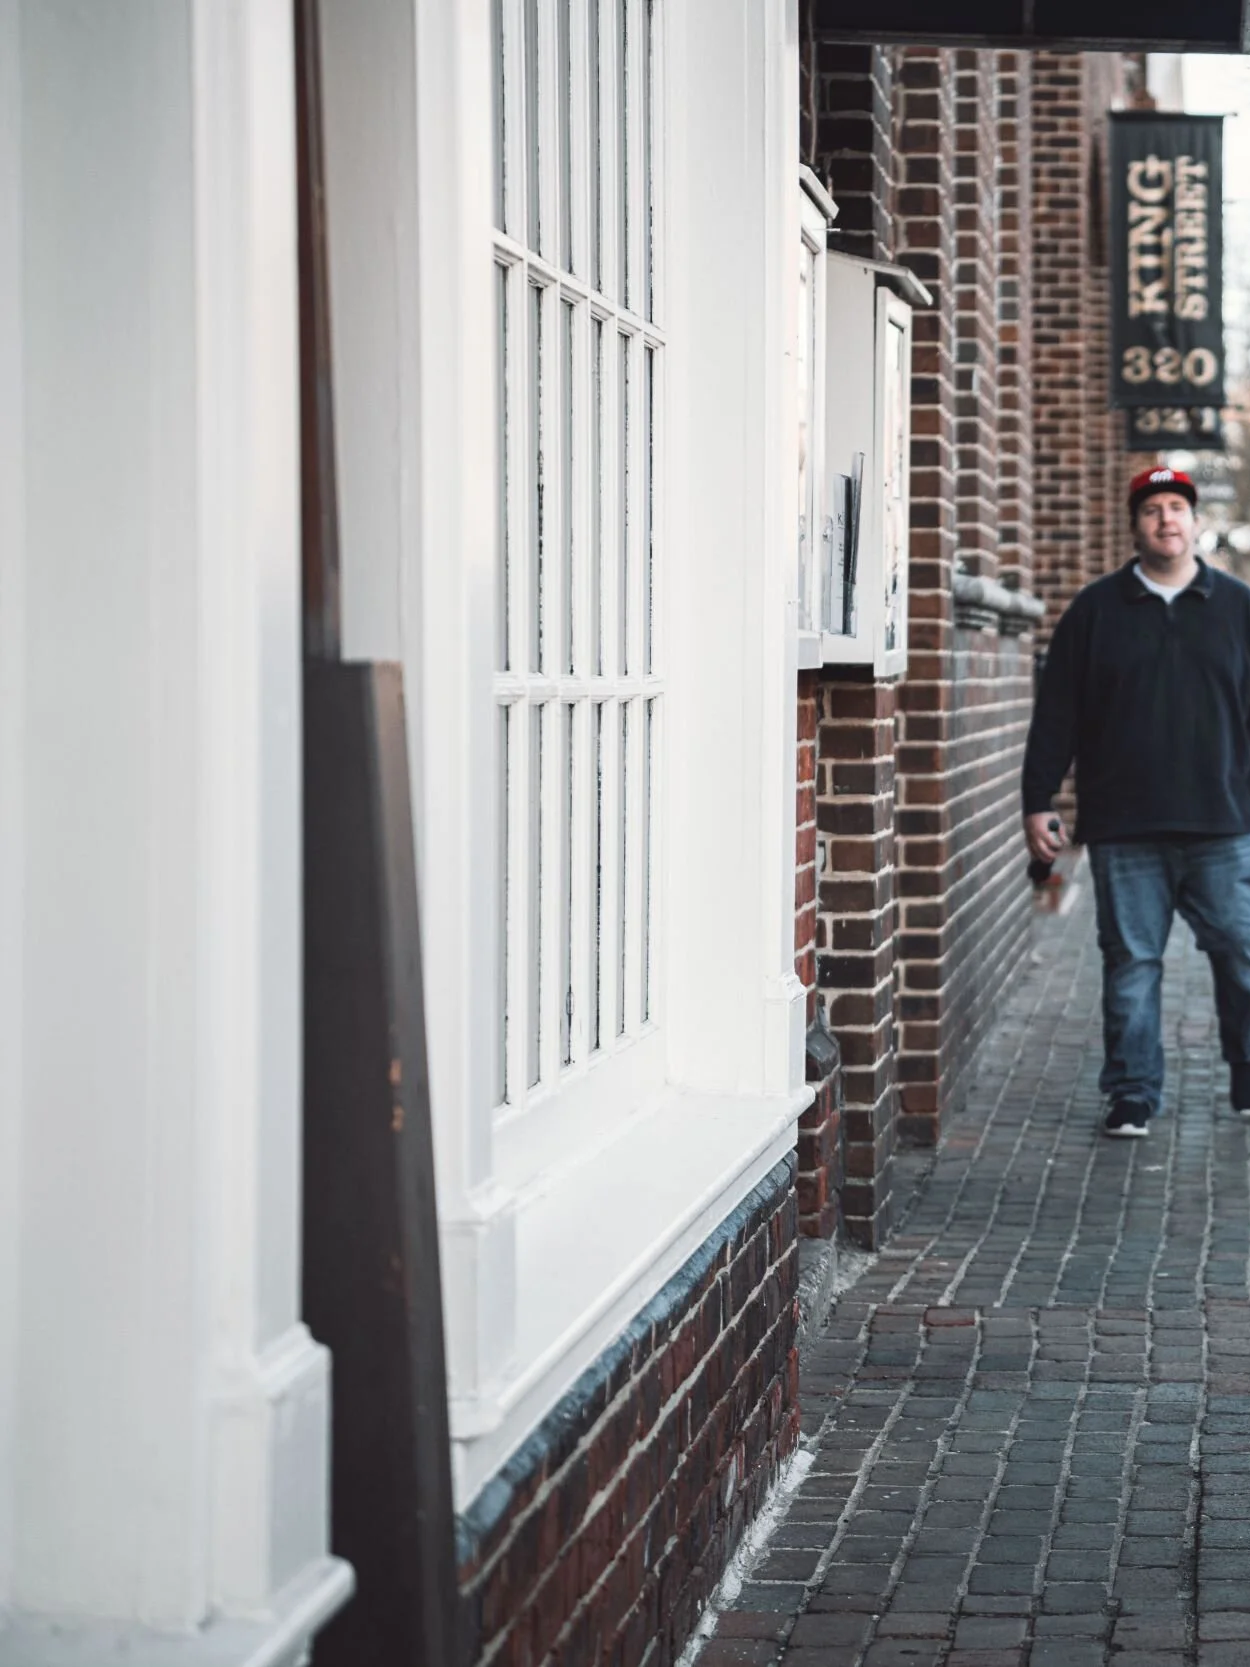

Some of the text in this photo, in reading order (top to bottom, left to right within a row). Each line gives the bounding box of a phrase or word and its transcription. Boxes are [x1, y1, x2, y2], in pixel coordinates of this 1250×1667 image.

[1127, 154, 1173, 320] KING
[1174, 155, 1209, 321] STREET
[1121, 346, 1218, 387] 320
